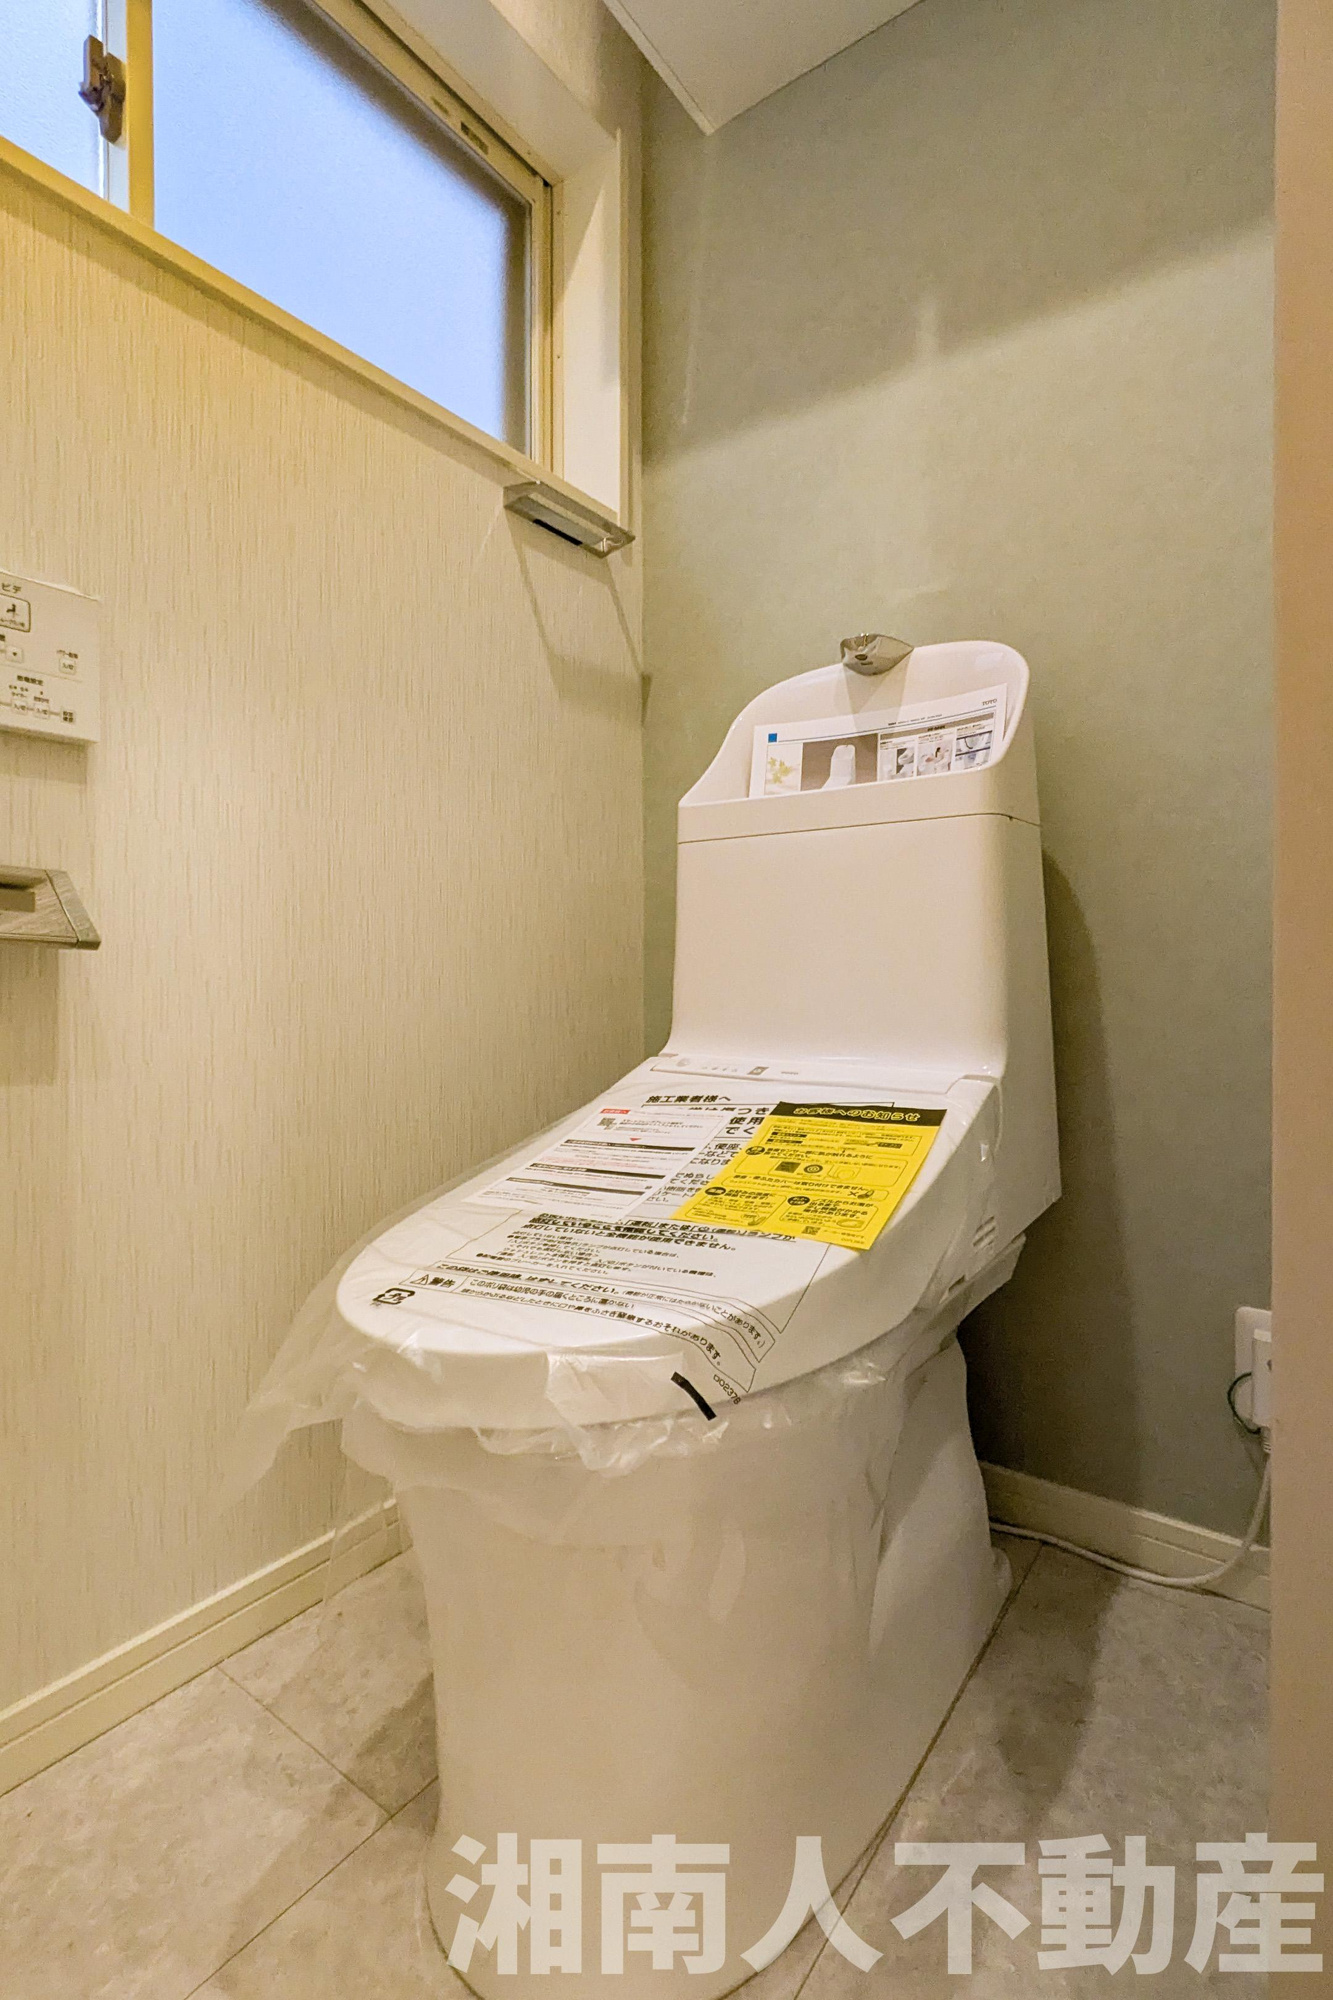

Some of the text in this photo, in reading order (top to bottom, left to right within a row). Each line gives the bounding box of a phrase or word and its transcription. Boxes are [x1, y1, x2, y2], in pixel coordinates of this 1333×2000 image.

[645, 1094, 731, 1104] 施工業者様へ
[793, 1107, 920, 1122] お客様へのお知らせ
[428, 1276, 456, 1289] 警告
